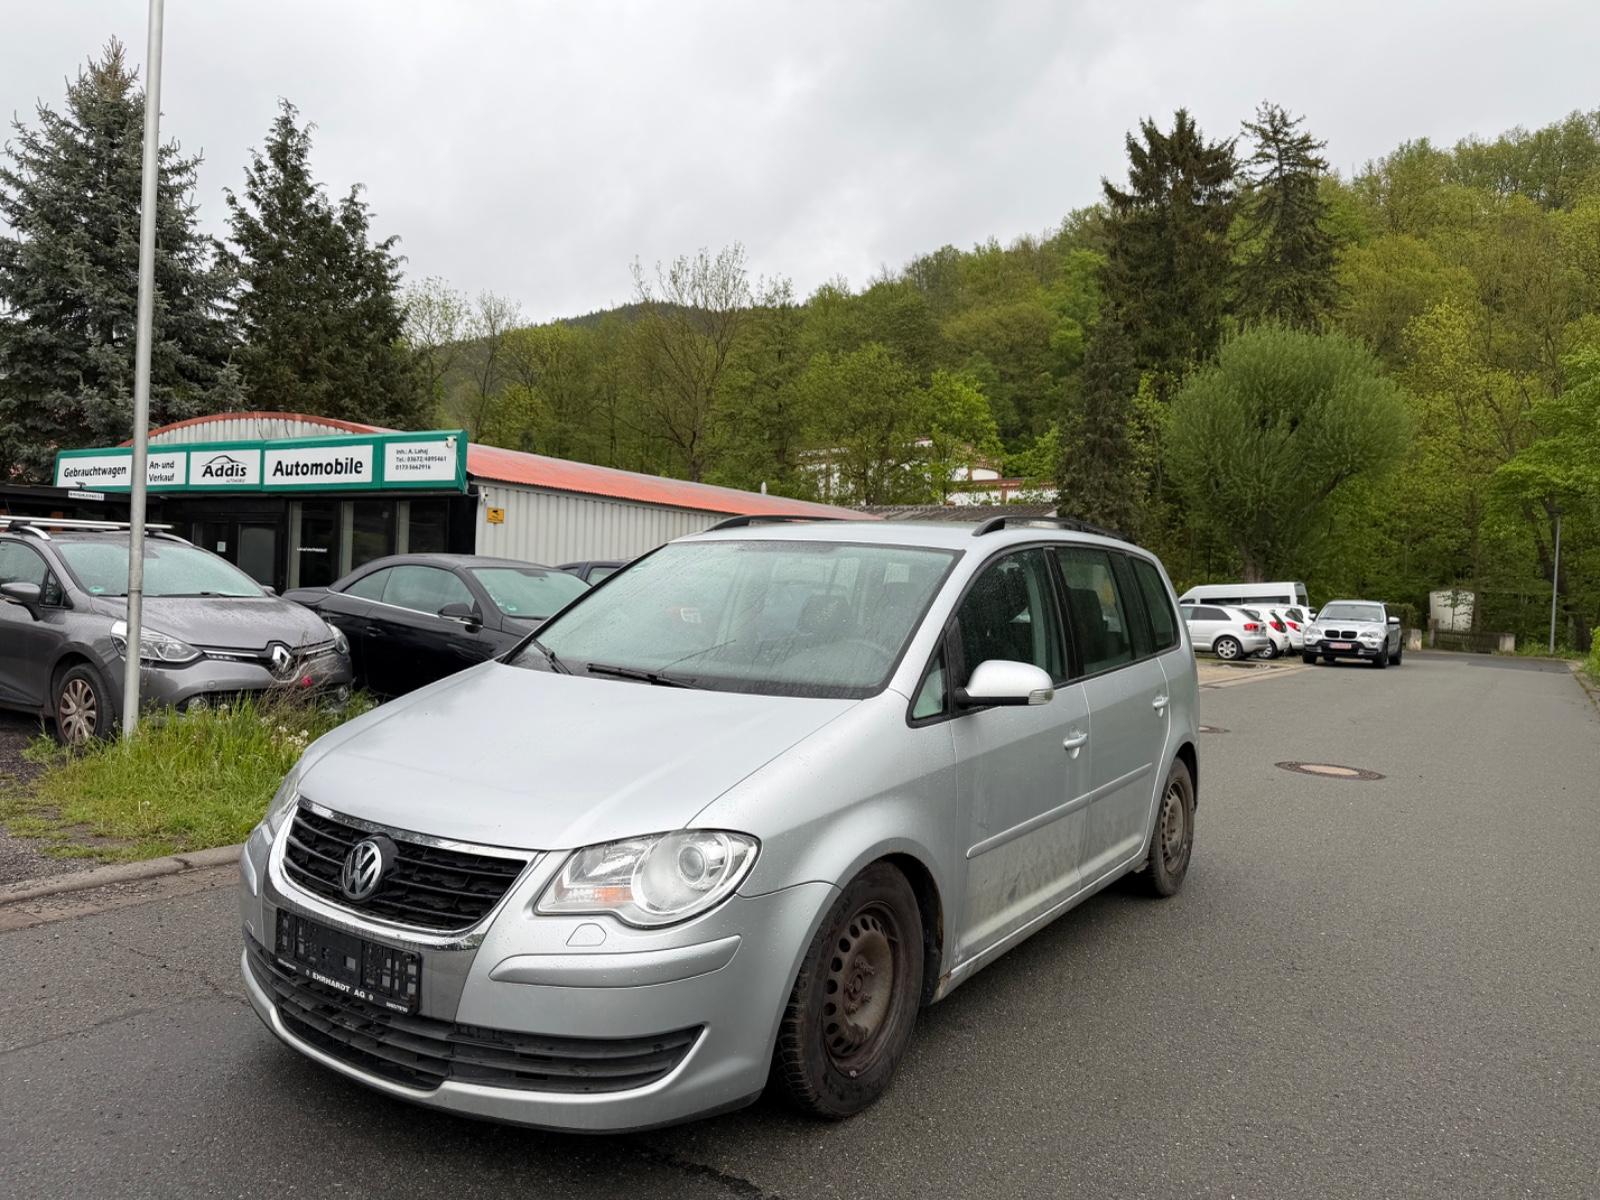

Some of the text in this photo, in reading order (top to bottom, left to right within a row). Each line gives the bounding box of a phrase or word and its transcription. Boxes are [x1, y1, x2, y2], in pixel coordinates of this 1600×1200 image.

[162, 460, 175, 469] und
[202, 464, 247, 478] Addis
[273, 457, 364, 477] Automobile
[64, 465, 126, 478] Gebrauchtwagen
[149, 473, 175, 482] Verkauf
[312, 972, 351, 992] EHRHARDT
